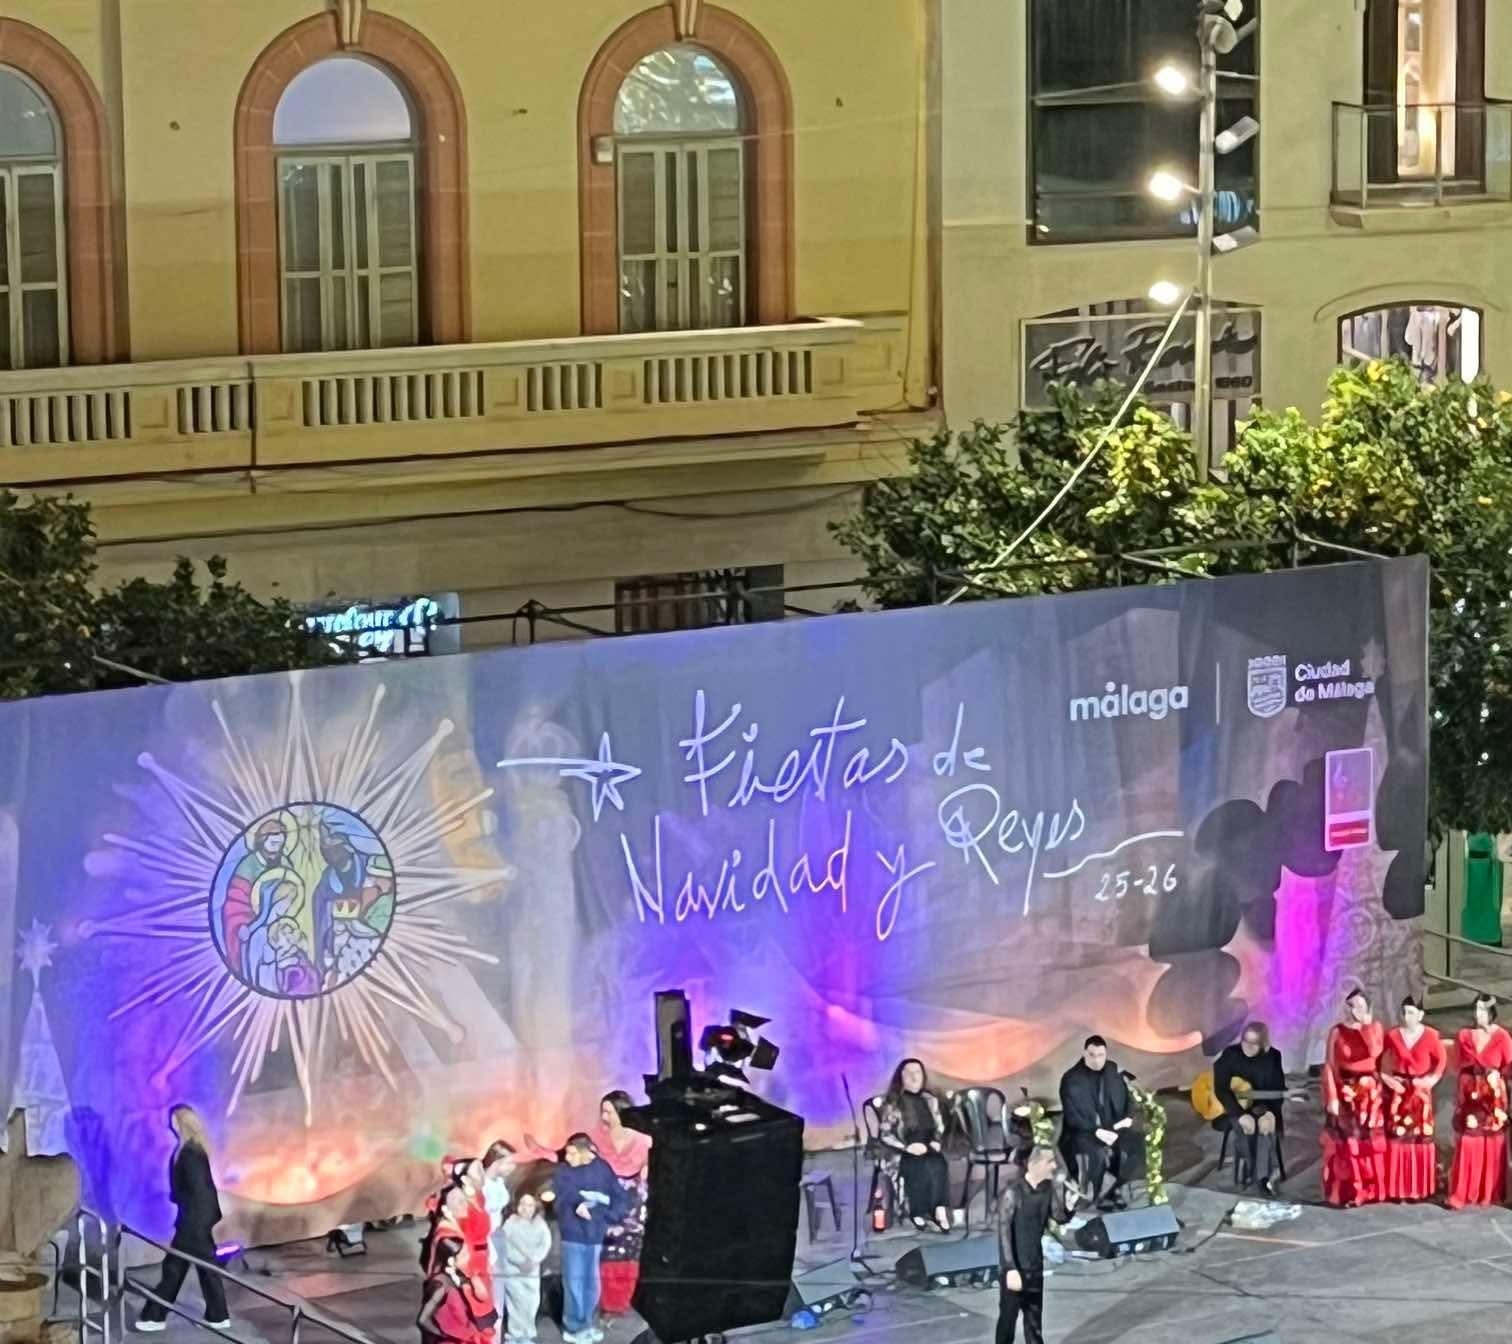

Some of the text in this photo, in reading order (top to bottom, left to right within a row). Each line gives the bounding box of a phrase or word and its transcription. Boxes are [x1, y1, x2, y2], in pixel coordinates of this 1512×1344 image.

[1295, 659, 1350, 681] Ciudad
[678, 689, 991, 816] Fiestas de
[620, 783, 1085, 941] Navidad y Reyes
[1094, 863, 1178, 901] 25-26
